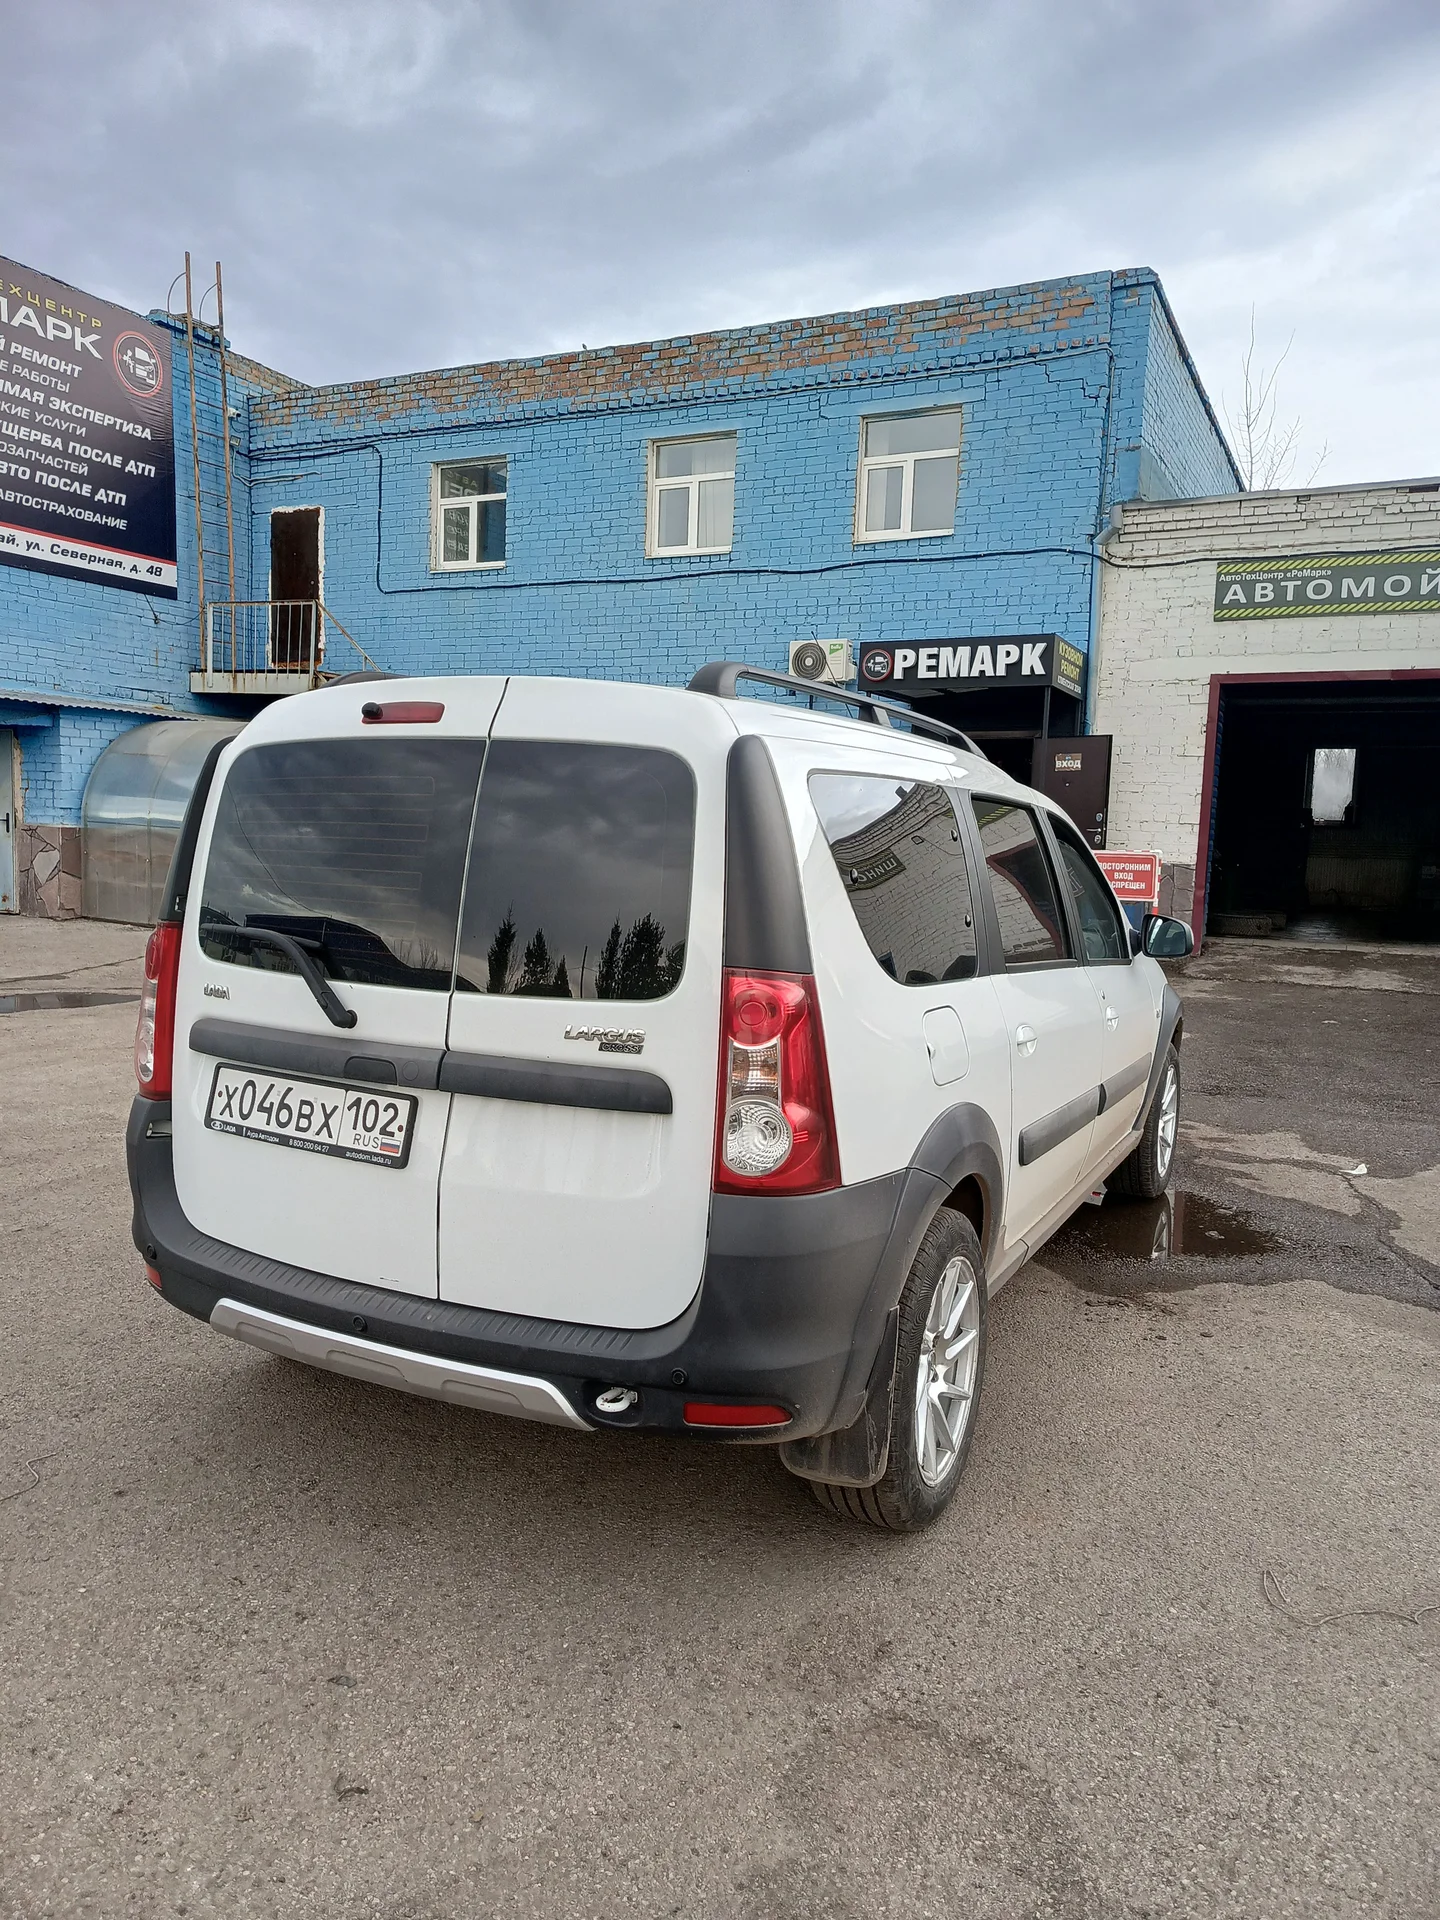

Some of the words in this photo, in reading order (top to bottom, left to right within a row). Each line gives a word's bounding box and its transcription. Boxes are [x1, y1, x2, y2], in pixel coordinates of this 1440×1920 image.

[9, 341, 83, 378] РЕМОНТ
[12, 363, 70, 393] РАБОТЫ
[0, 400, 31, 420] КИЕ
[34, 411, 87, 438] УСЛУГИ
[48, 396, 152, 441] ЭКСПЕРТИЗА
[0, 419, 63, 451] ЩЕРБА
[67, 441, 123, 468] ПОСЛЕ
[124, 459, 156, 478] ДТП
[35, 471, 92, 498] ПОСЛЕ
[94, 488, 127, 506] ДТП
[25, 540, 45, 552] ул.
[50, 543, 126, 570] Северная,
[129, 564, 142, 574] д.
[145, 564, 163, 577] 48
[1222, 567, 1440, 604] АВТОМОЙ
[893, 642, 1048, 680] РЕМАРК
[1056, 760, 1081, 769] ВХОД
[1110, 880, 1146, 889] СПРЕЩЕН
[1114, 872, 1133, 880] ВХОД
[564, 1024, 646, 1043] LARGUS
[600, 1043, 640, 1053] CROSS
[347, 1096, 399, 1137] 102
[223, 1124, 236, 1133] LADA
[304, 1141, 314, 1150] 200
[345, 1151, 392, 1165] autodom.lada.ru
[353, 1133, 379, 1149] RUS
